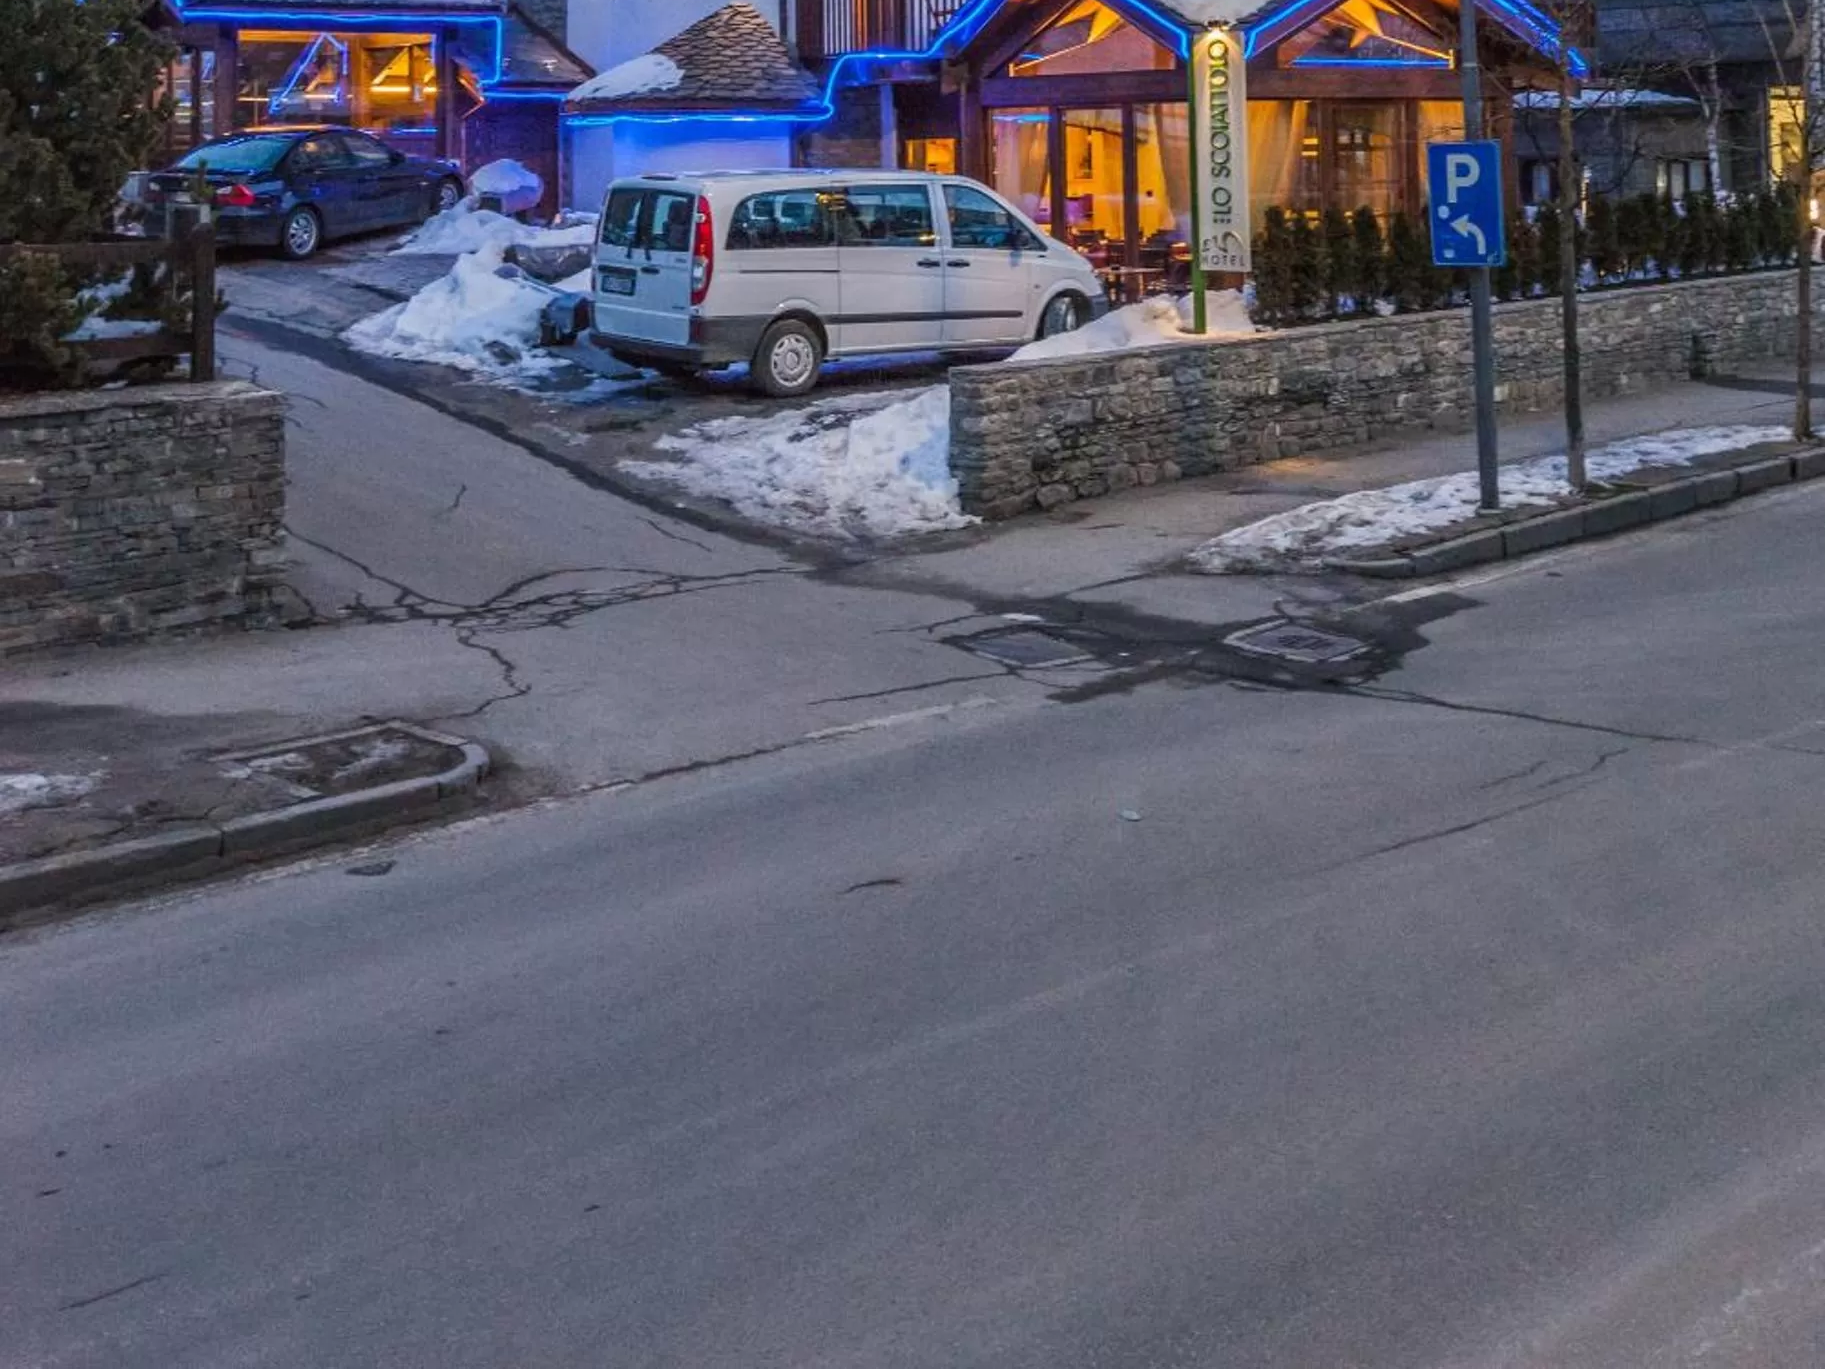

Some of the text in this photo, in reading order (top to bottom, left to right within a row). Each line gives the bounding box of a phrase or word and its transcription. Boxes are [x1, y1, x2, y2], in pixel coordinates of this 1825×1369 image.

[1207, 39, 1233, 217] LO SCOIATTOLO
[1446, 153, 1481, 204] P
